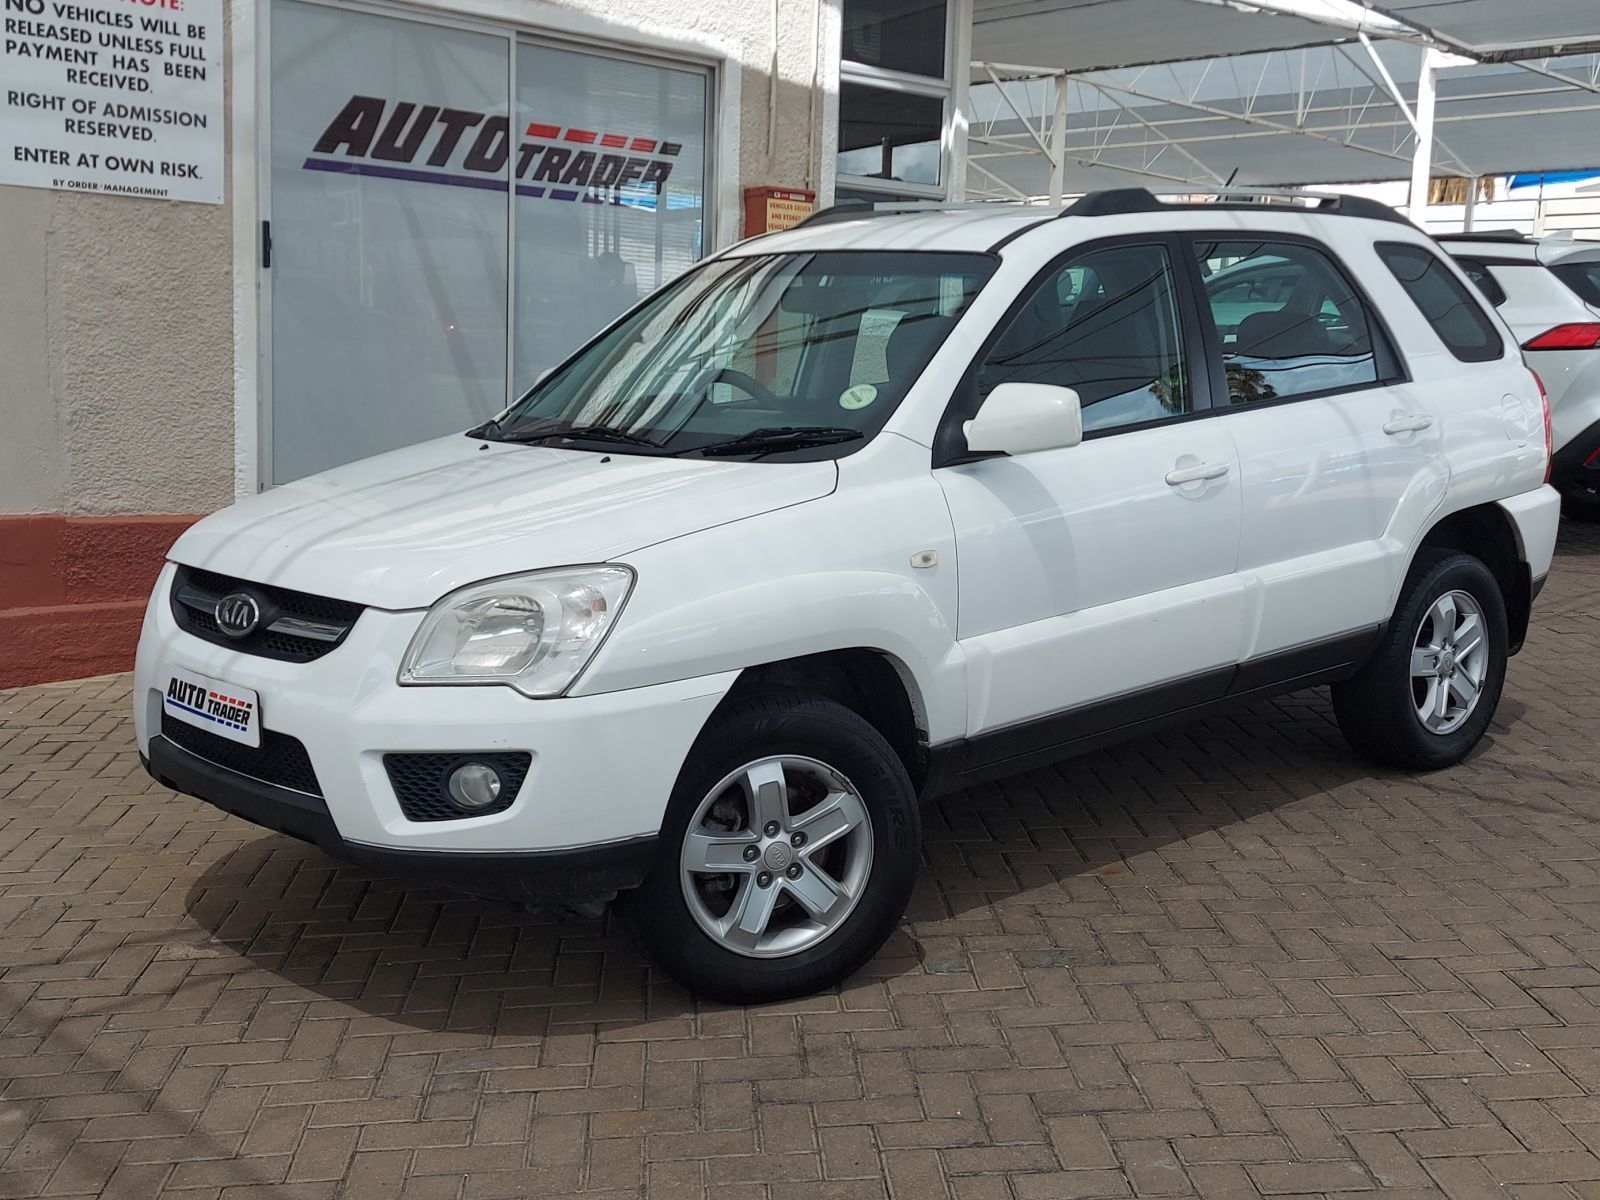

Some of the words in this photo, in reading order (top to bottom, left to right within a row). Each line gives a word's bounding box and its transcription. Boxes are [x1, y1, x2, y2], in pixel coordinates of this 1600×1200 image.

[5, 0, 45, 15] NO
[53, 3, 133, 29] VEHICLES
[140, 16, 180, 37] WILL
[187, 24, 206, 40] BE
[5, 18, 92, 44] RELEASED
[99, 32, 163, 55] UNLESS
[170, 43, 206, 61] FULL
[5, 39, 98, 66] PAYMENT
[112, 54, 150, 73] HAS
[164, 62, 206, 81] BEEN
[67, 69, 153, 94] RECEIVED.
[7, 90, 66, 111] RIGHT
[72, 98, 97, 115] OF
[102, 102, 207, 128] ADMISSION
[64, 118, 157, 143] RESERVED.
[312, 95, 509, 173] AUTO
[515, 143, 673, 195] TRADER
[14, 146, 70, 167] ENTER
[77, 153, 99, 169] AT
[105, 156, 154, 174] OWN
[160, 161, 203, 180] RISK.
[52, 179, 65, 187] BY
[67, 180, 98, 190] ORDER
[103, 183, 169, 197] MANAGEMENT
[221, 600, 249, 627] KIA
[167, 677, 206, 710] AUTO
[207, 699, 251, 726] TRADER
